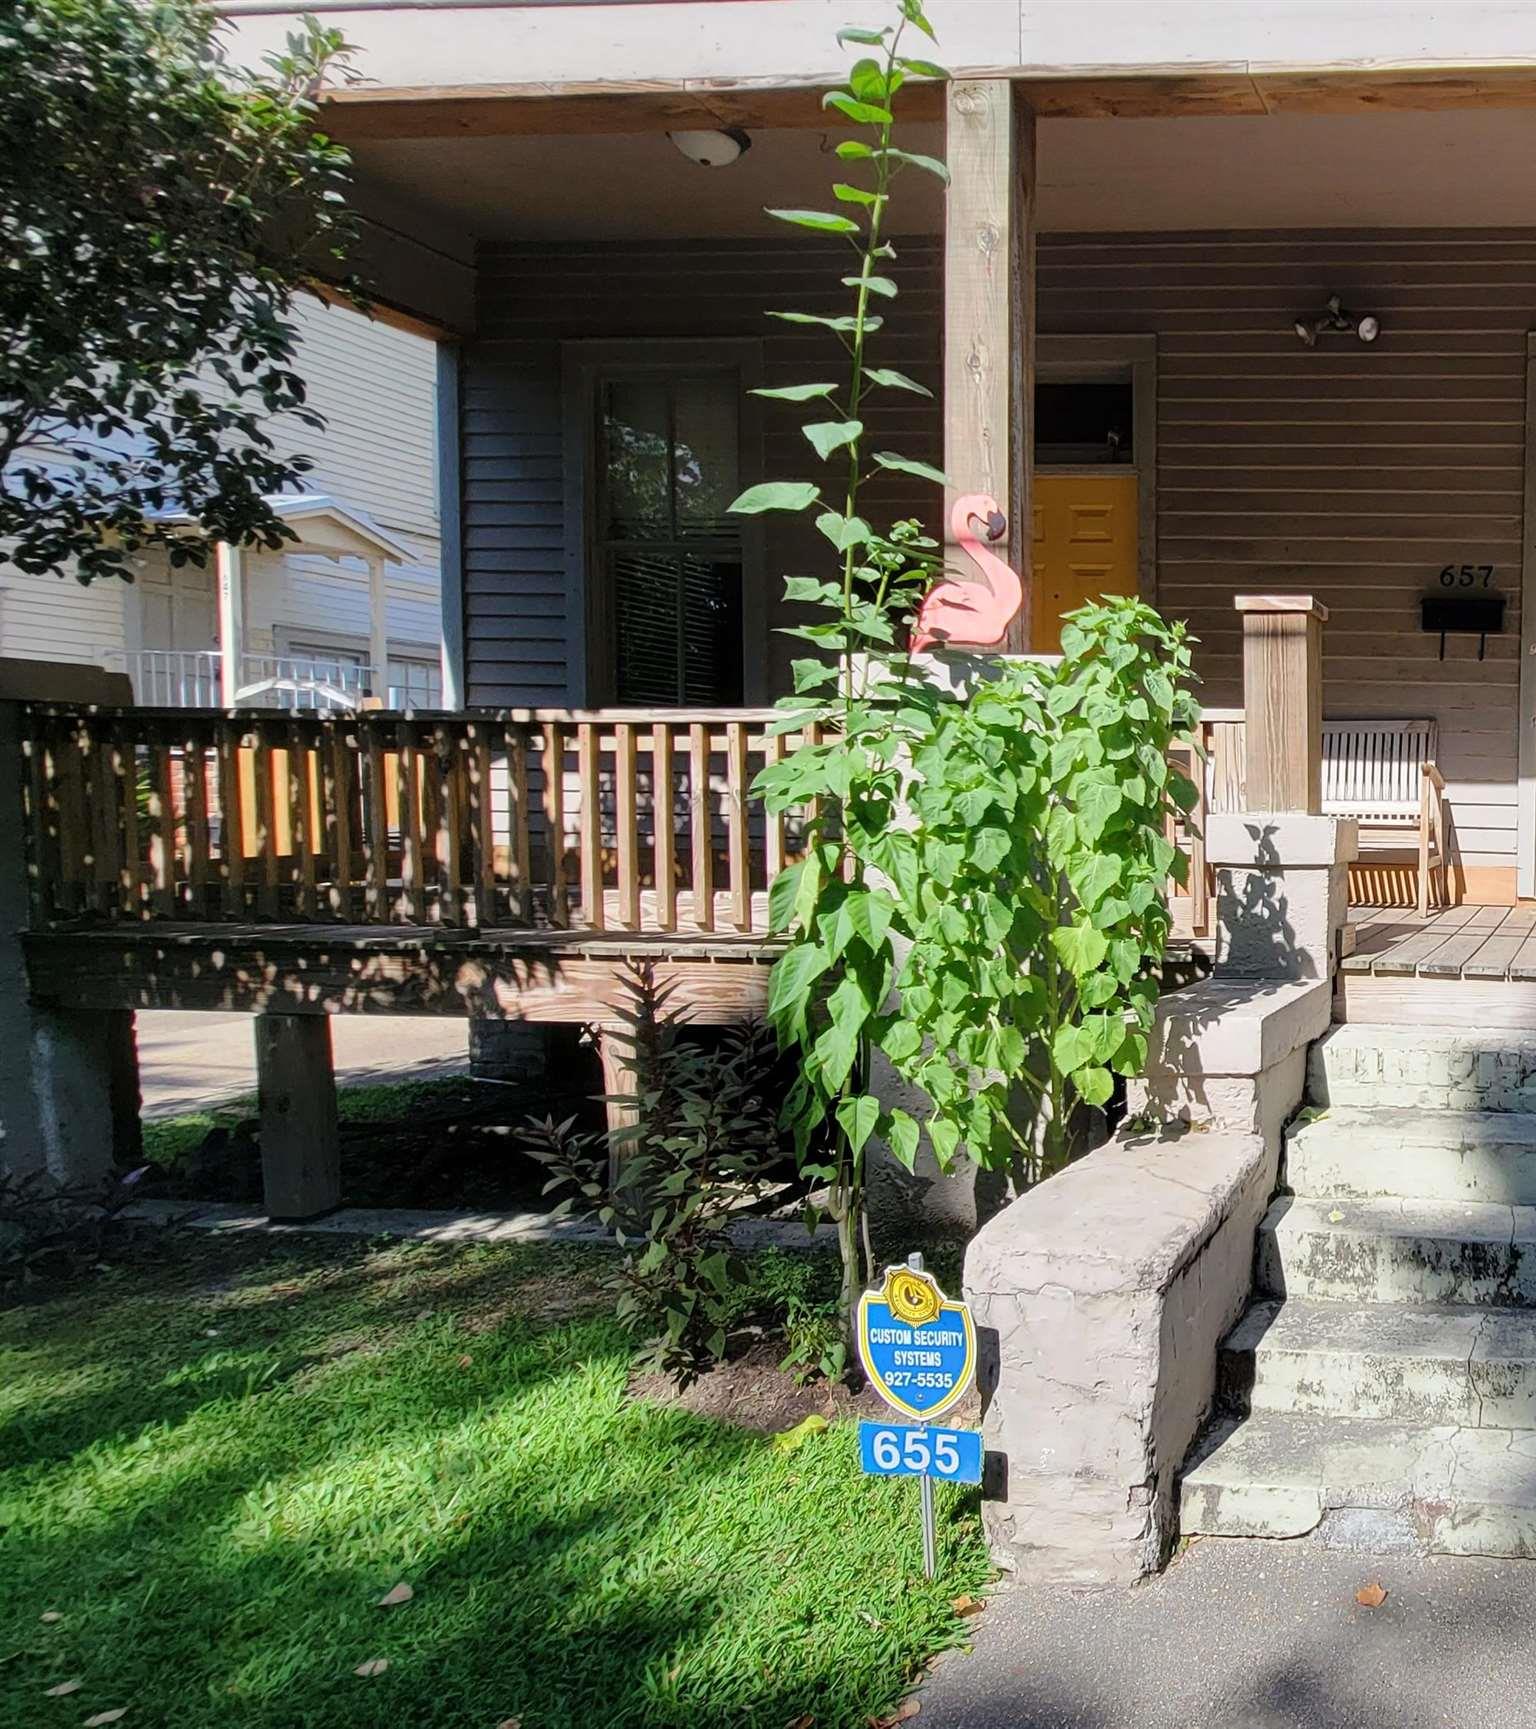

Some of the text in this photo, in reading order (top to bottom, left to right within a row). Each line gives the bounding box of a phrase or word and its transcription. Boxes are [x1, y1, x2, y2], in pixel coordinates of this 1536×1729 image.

[1440, 564, 1493, 588] 657
[870, 1327, 963, 1347] CUSTOM SECURITY
[894, 1350, 942, 1367] SYSTEMS
[884, 1370, 953, 1388] 927-5535
[873, 1430, 960, 1475] 655
